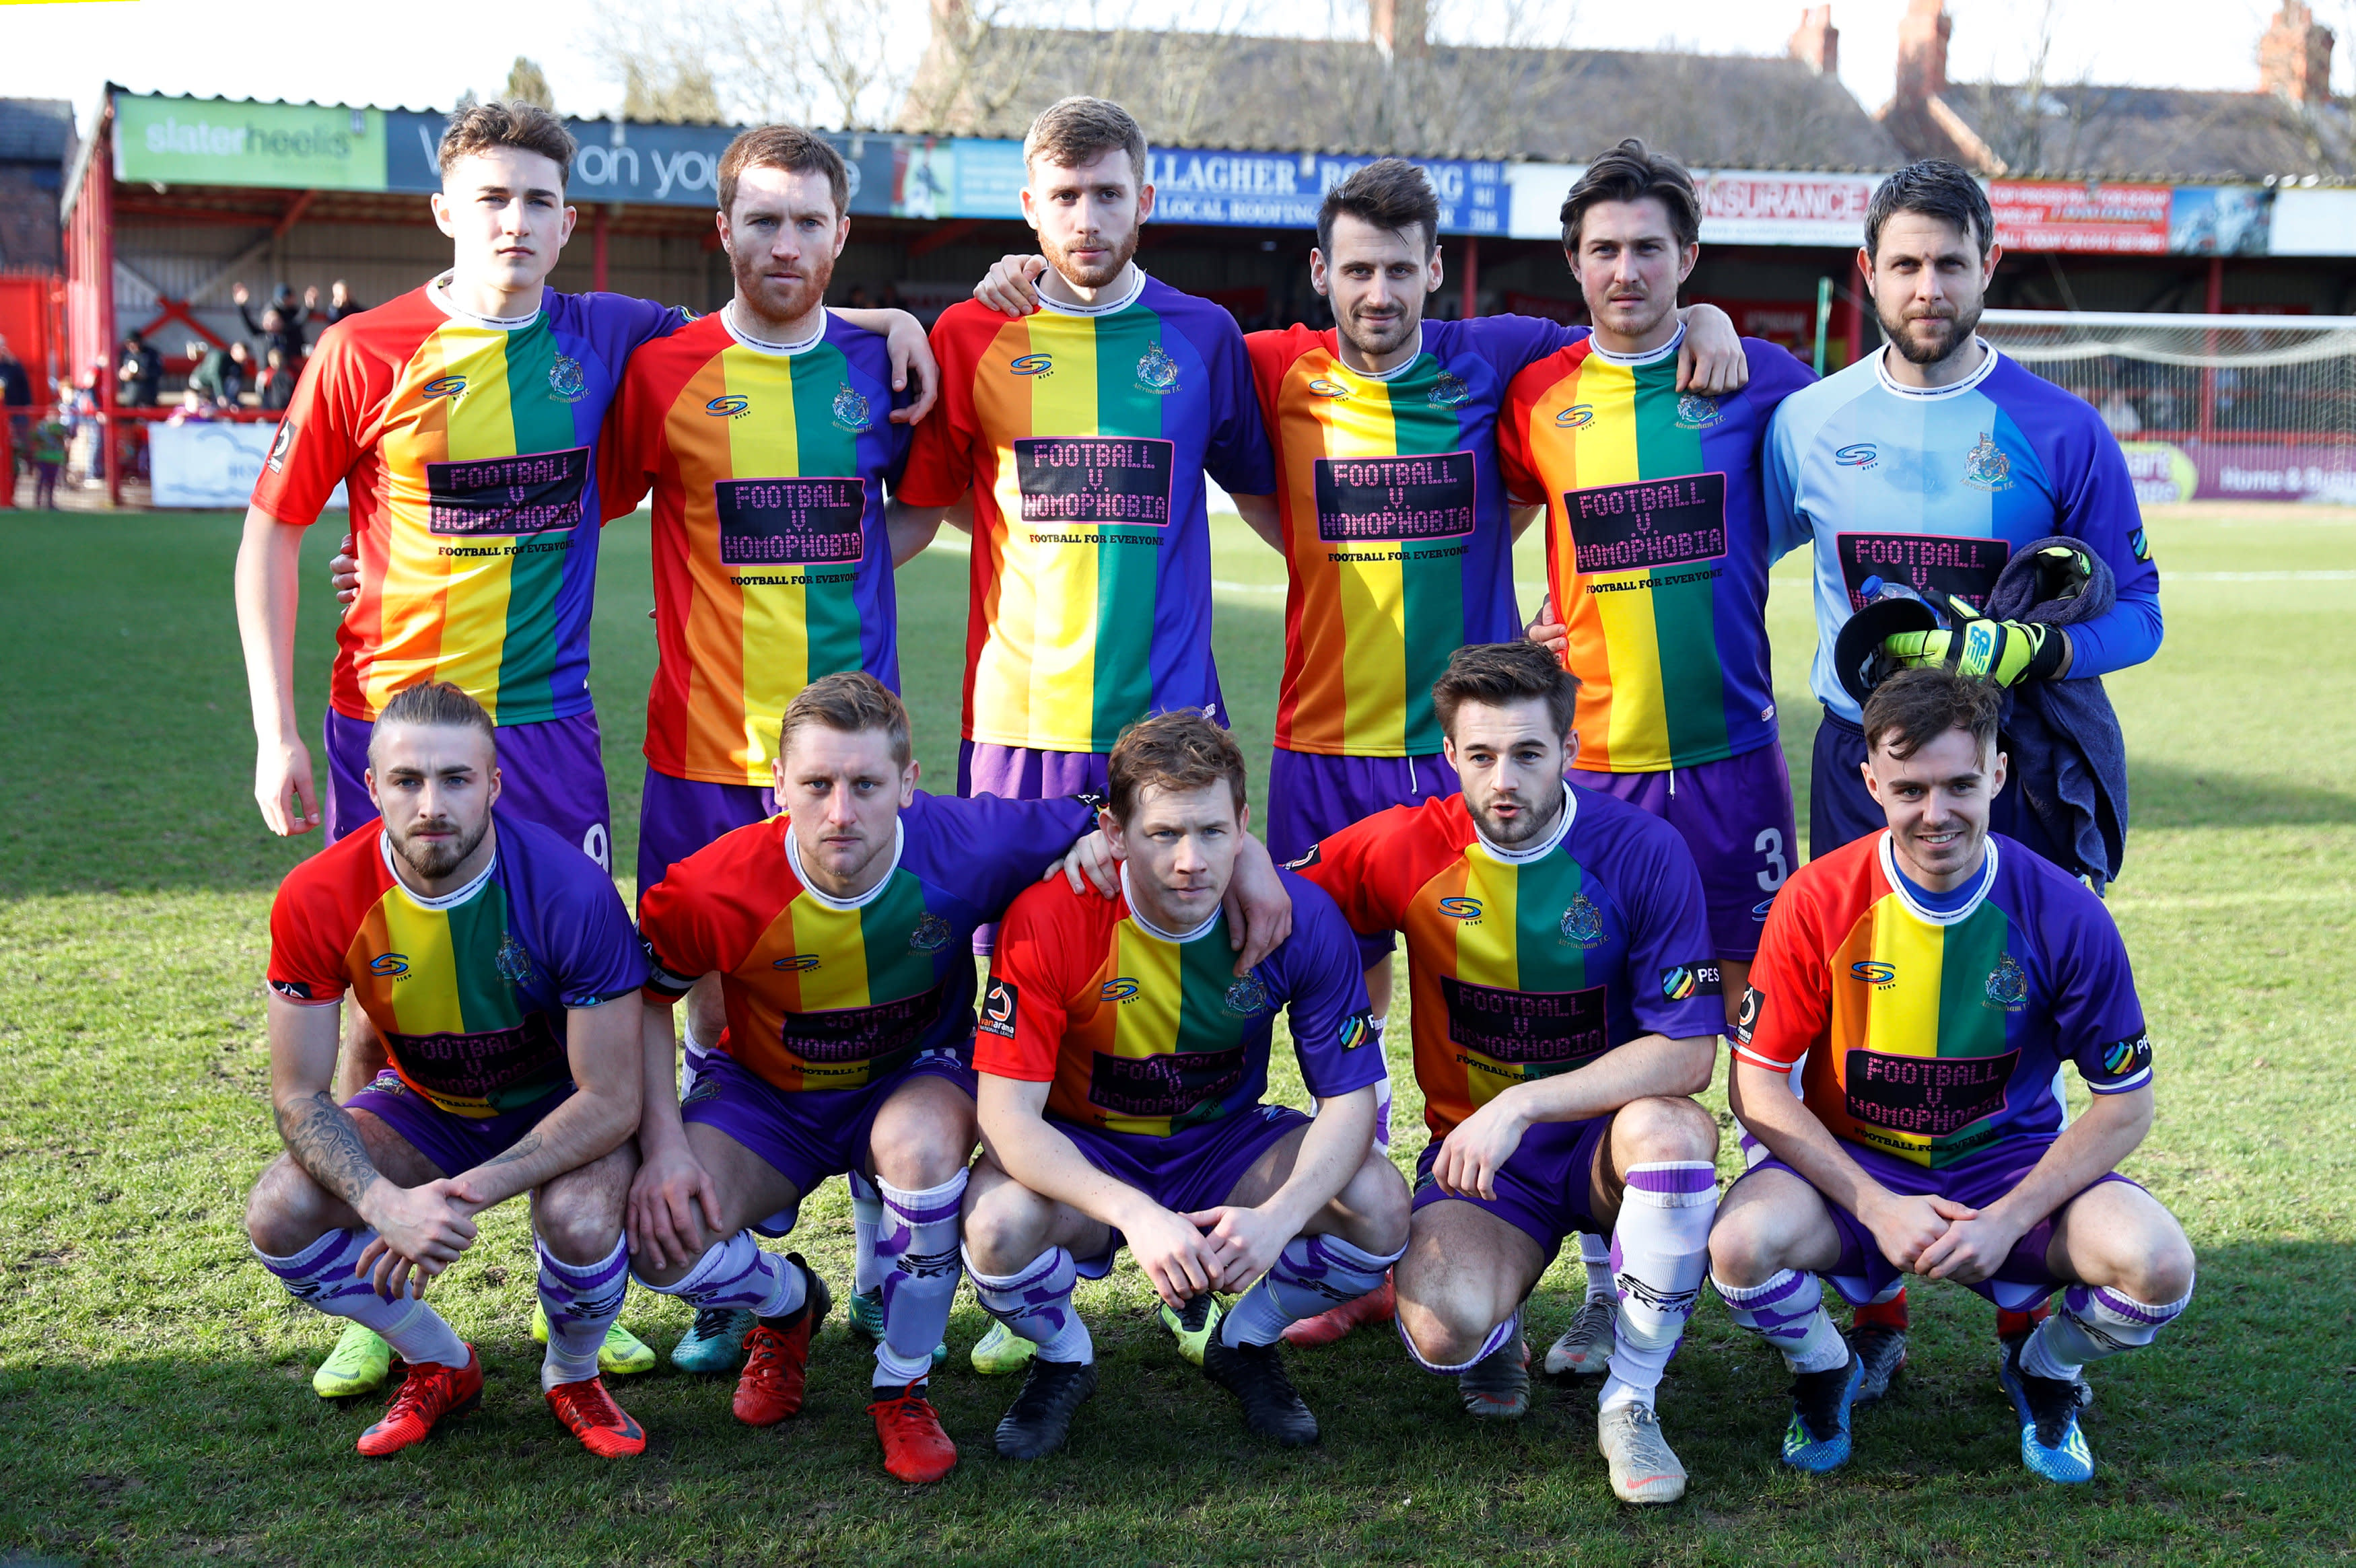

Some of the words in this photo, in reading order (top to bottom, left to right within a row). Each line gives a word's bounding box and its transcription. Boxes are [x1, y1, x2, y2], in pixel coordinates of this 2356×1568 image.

[577, 145, 639, 186] on
[1145, 154, 1297, 195] LLAGHER
[1033, 443, 1155, 469] FOOTBALL
[450, 456, 573, 490] FOOTBALL
[1088, 468, 1103, 491] V
[1334, 461, 1457, 487] FOOTBALL
[508, 485, 525, 505] V
[735, 485, 850, 509] FOOTBALL
[1024, 487, 1165, 519] HOMOPHOBIA
[1389, 487, 1404, 509] V
[1579, 482, 1706, 518] FOOTBALL
[791, 509, 806, 531] V
[1323, 505, 1470, 536] HOMOPHOBIA
[1636, 512, 1651, 536] V
[438, 546, 501, 557] FOOTBALL
[504, 546, 525, 555] FOR
[527, 538, 575, 553] EVERYONE
[725, 528, 860, 558] HOMOPHOBIA
[1029, 534, 1082, 544] FOOTBALL
[1084, 534, 1106, 544] FOR
[1109, 535, 1164, 545] EVERYONE
[1577, 528, 1723, 568] HOMOPHOBIA
[1328, 553, 1386, 563] FOOTBALL
[1387, 551, 1411, 561] FOR
[1413, 545, 1469, 561] EVERYONE
[1855, 539, 1985, 568] FOOTBALL
[730, 576, 788, 585] FOOTBALL
[791, 575, 813, 585] FOR
[815, 572, 860, 583] EVERYONE
[1586, 581, 1636, 594] FOOTBALL
[1639, 578, 1663, 589] FOR
[1665, 569, 1723, 585] EVERYONE
[1912, 566, 1927, 590] V
[1754, 827, 1788, 892] 3
[1696, 966, 1720, 984] PES
[1459, 985, 1586, 1018] FOOTBALL
[979, 1025, 1000, 1034] NATIONAL
[1000, 1030, 1014, 1039] LEAGUE
[981, 1018, 1014, 1034] vanarama
[1513, 1016, 1529, 1038] V
[403, 1030, 536, 1061] FOOTBALL
[791, 1063, 854, 1075] FOOTBALL
[1456, 1054, 1511, 1079] FOOTBALL
[1867, 1057, 1999, 1086] FOOTBALL
[1926, 1087, 1943, 1108] V
[1854, 1127, 1915, 1151] FOOTBALL
